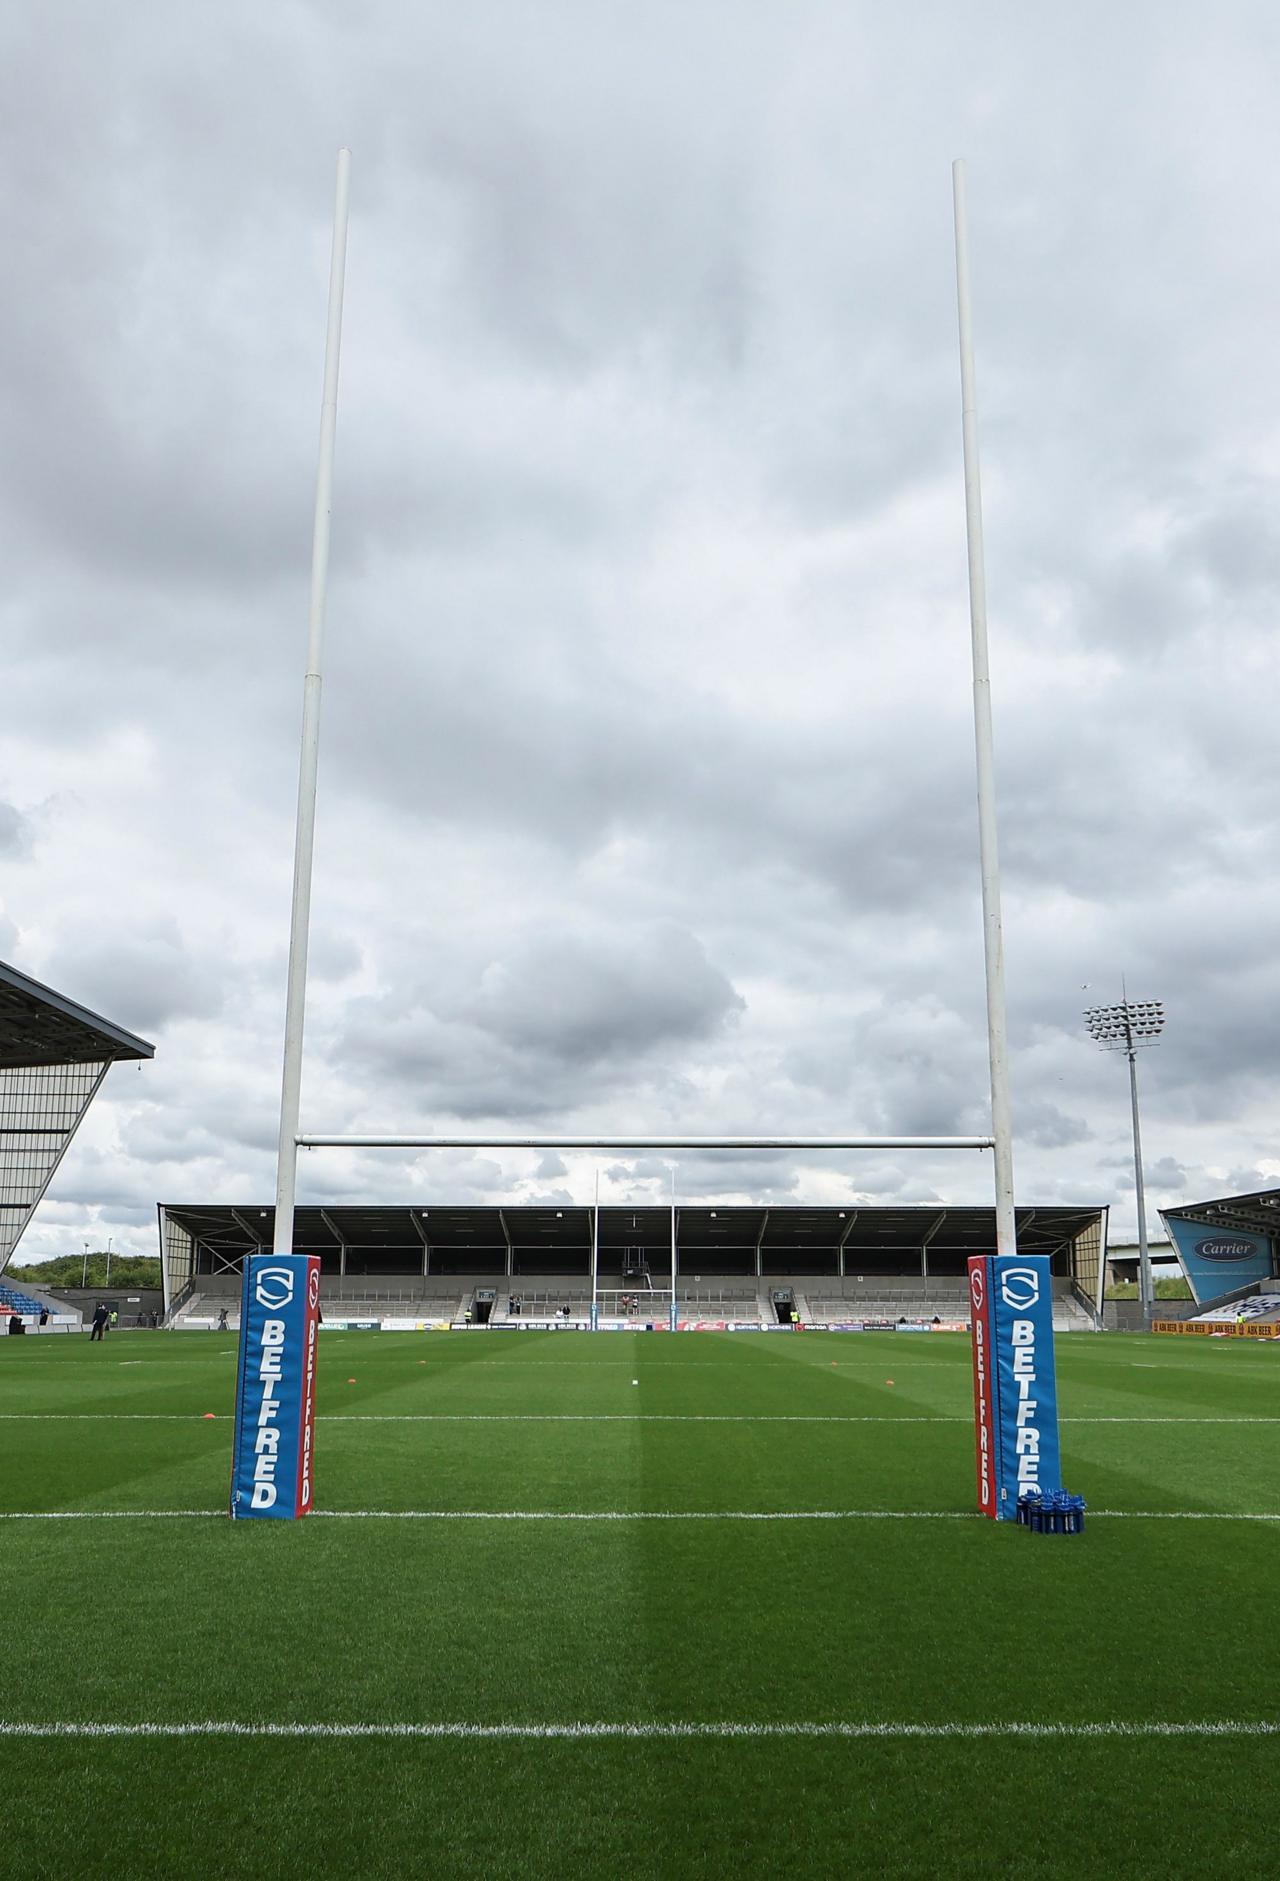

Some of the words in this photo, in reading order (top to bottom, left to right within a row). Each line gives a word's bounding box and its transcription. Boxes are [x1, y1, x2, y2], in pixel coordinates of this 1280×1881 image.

[1202, 1242, 1251, 1254] Carrier
[1248, 1325, 1257, 1335] ABK
[1259, 1326, 1271, 1335] BEER
[251, 1319, 286, 1509] BETFRED
[301, 1319, 315, 1507] BETFRED
[976, 1320, 989, 1505] BETFRED
